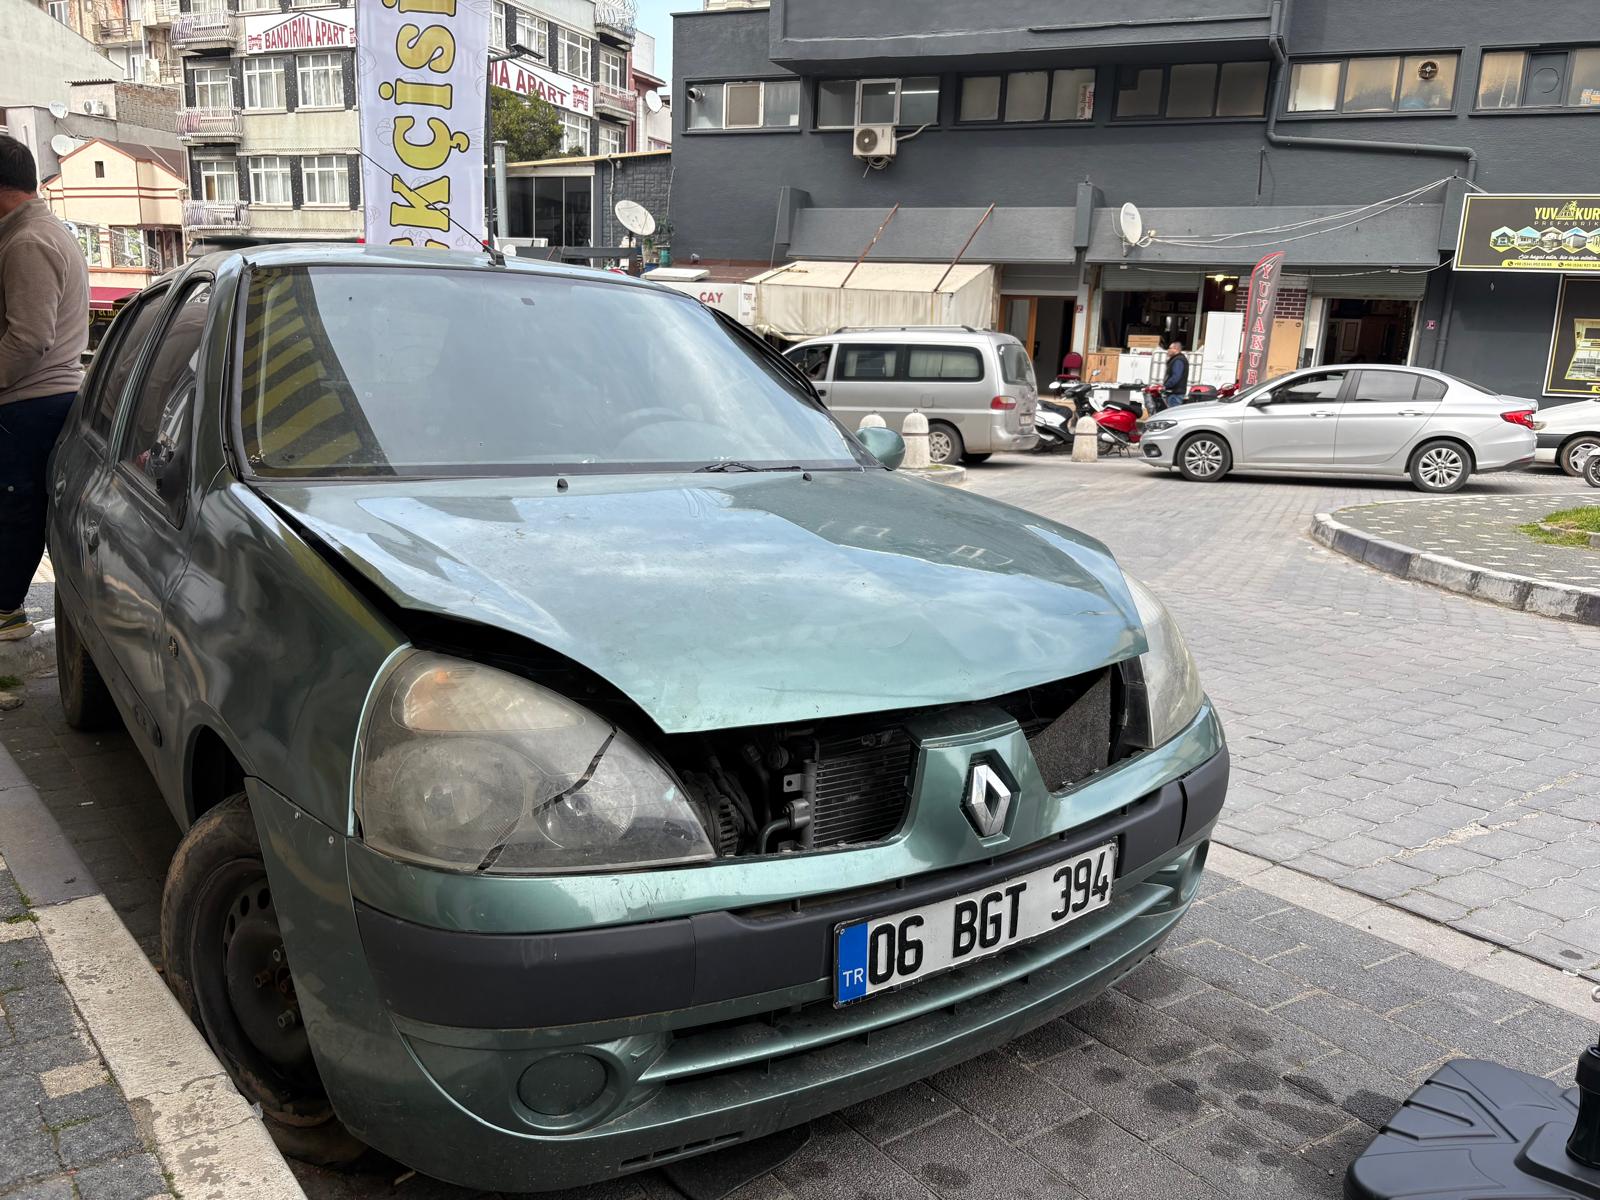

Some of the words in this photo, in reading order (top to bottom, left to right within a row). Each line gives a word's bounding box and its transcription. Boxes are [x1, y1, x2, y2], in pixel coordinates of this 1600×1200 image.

[264, 16, 313, 49] BANDIRMA
[315, 20, 345, 46] APART
[515, 68, 567, 105] APART
[1246, 264, 1273, 385] YUVAKUR
[868, 914, 925, 985] 06
[952, 881, 1027, 958] BGT
[1051, 851, 1110, 922] 394
[842, 967, 865, 988] TR
